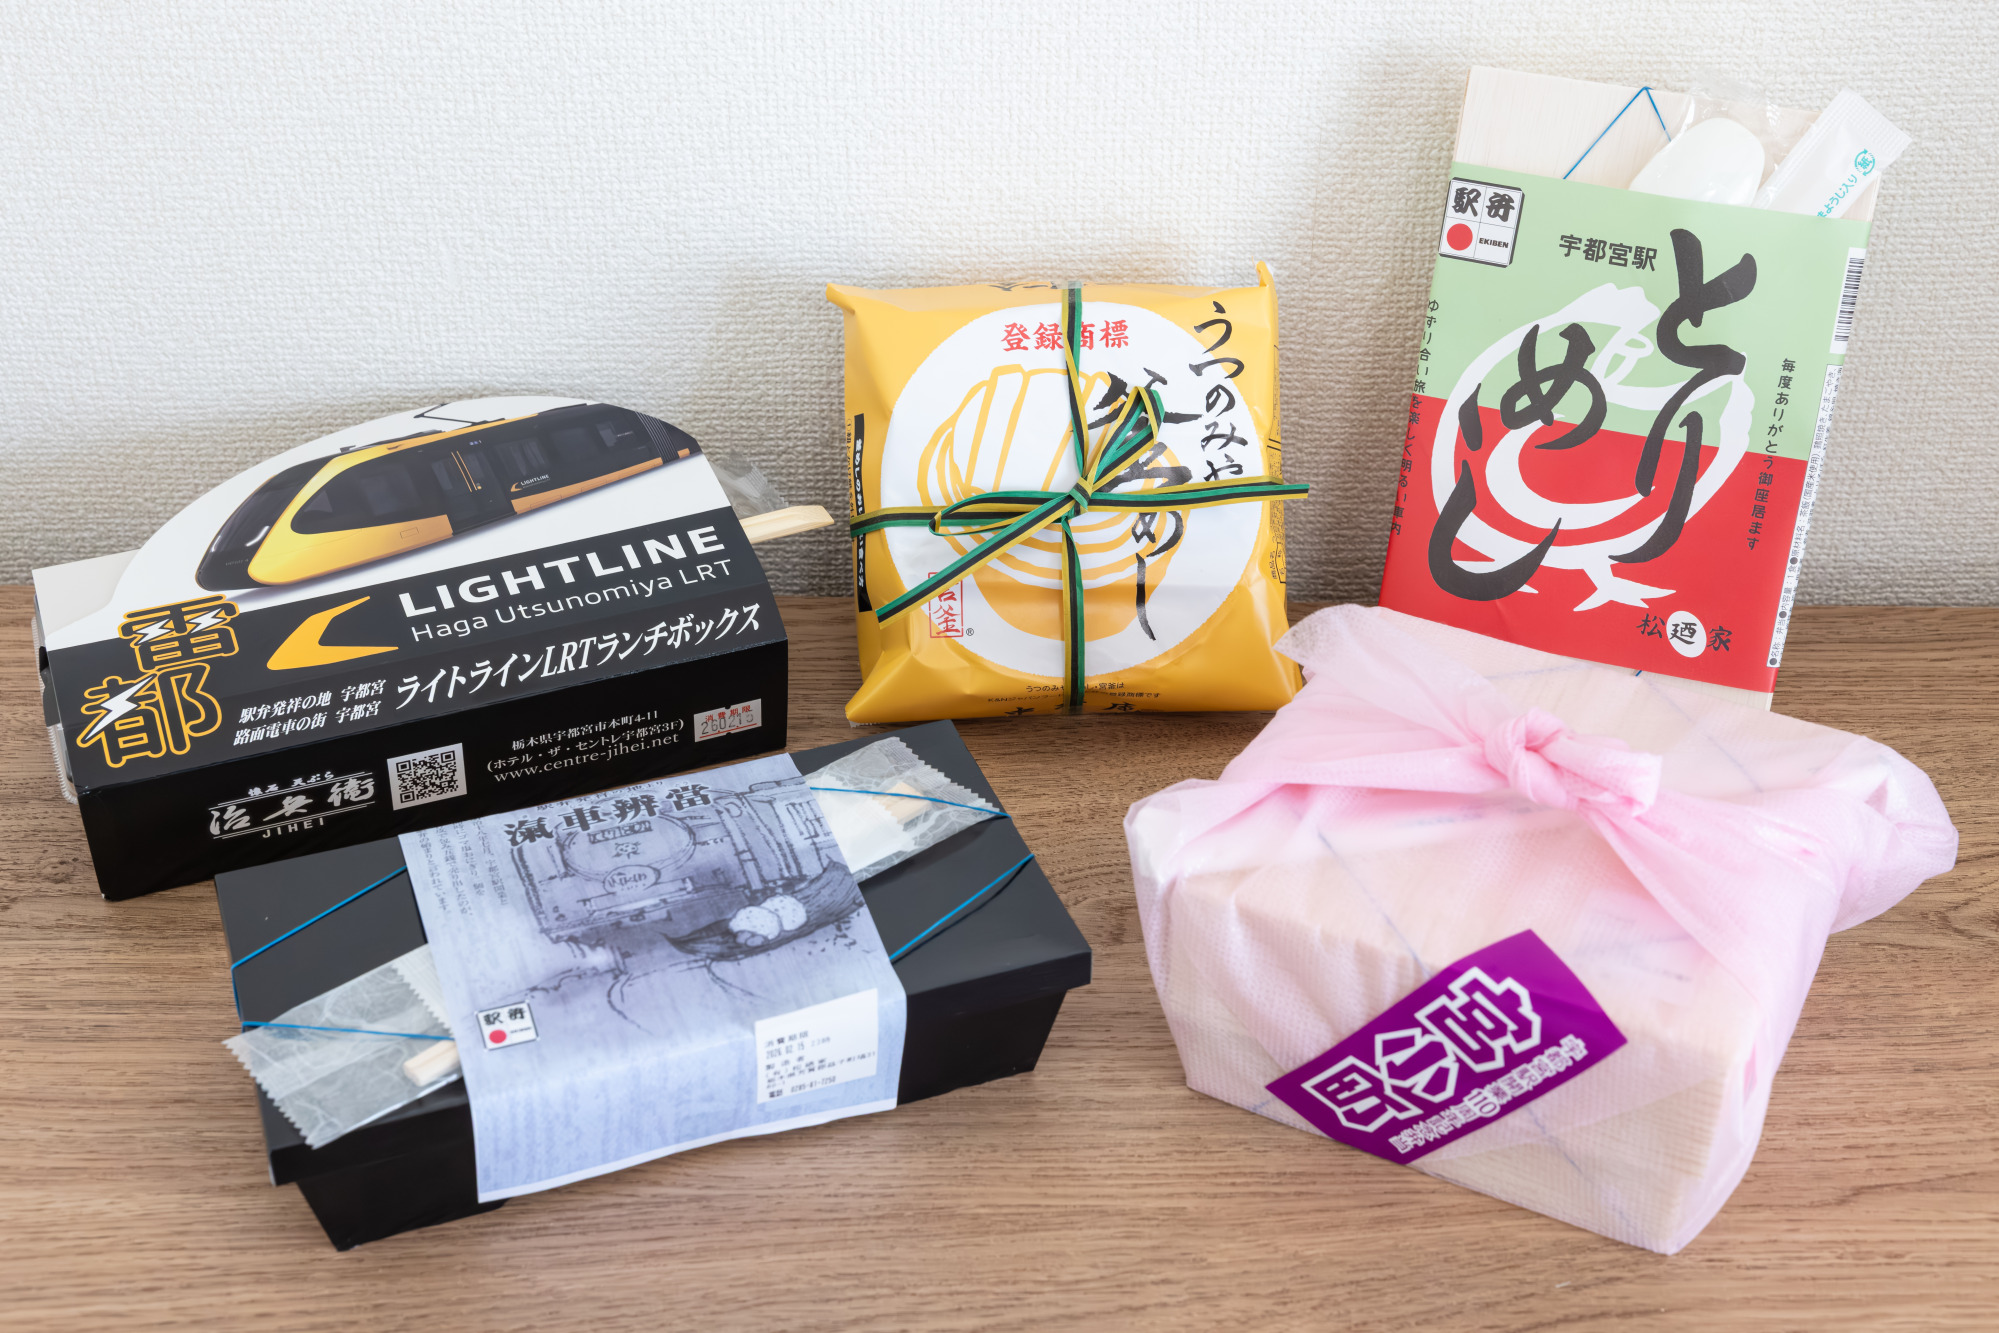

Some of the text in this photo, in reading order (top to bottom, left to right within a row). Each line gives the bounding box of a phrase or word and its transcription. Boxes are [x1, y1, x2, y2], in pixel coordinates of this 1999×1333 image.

[1478, 237, 1509, 249] EKIBEN
[1559, 233, 1657, 272] 宇都宮駅
[1189, 301, 1248, 481] うつのみや
[1747, 357, 1796, 551] 毎度ありがとう御座居ます
[520, 474, 550, 487] LIGHTLINE
[399, 525, 726, 618] LIGHTLINE
[411, 558, 732, 642] Haga Utsunomiya LRT
[395, 602, 761, 710] ライトラインLRTランチボックス
[233, 701, 379, 746] 路面電車の街 宇都宮
[239, 679, 386, 724] 駅弁発祥の地 宇都宮
[511, 709, 659, 750] 栃木県宇都宮市本町4-11
[494, 732, 680, 783] www.centre-jihei.net
[262, 817, 326, 839] JIHEI
